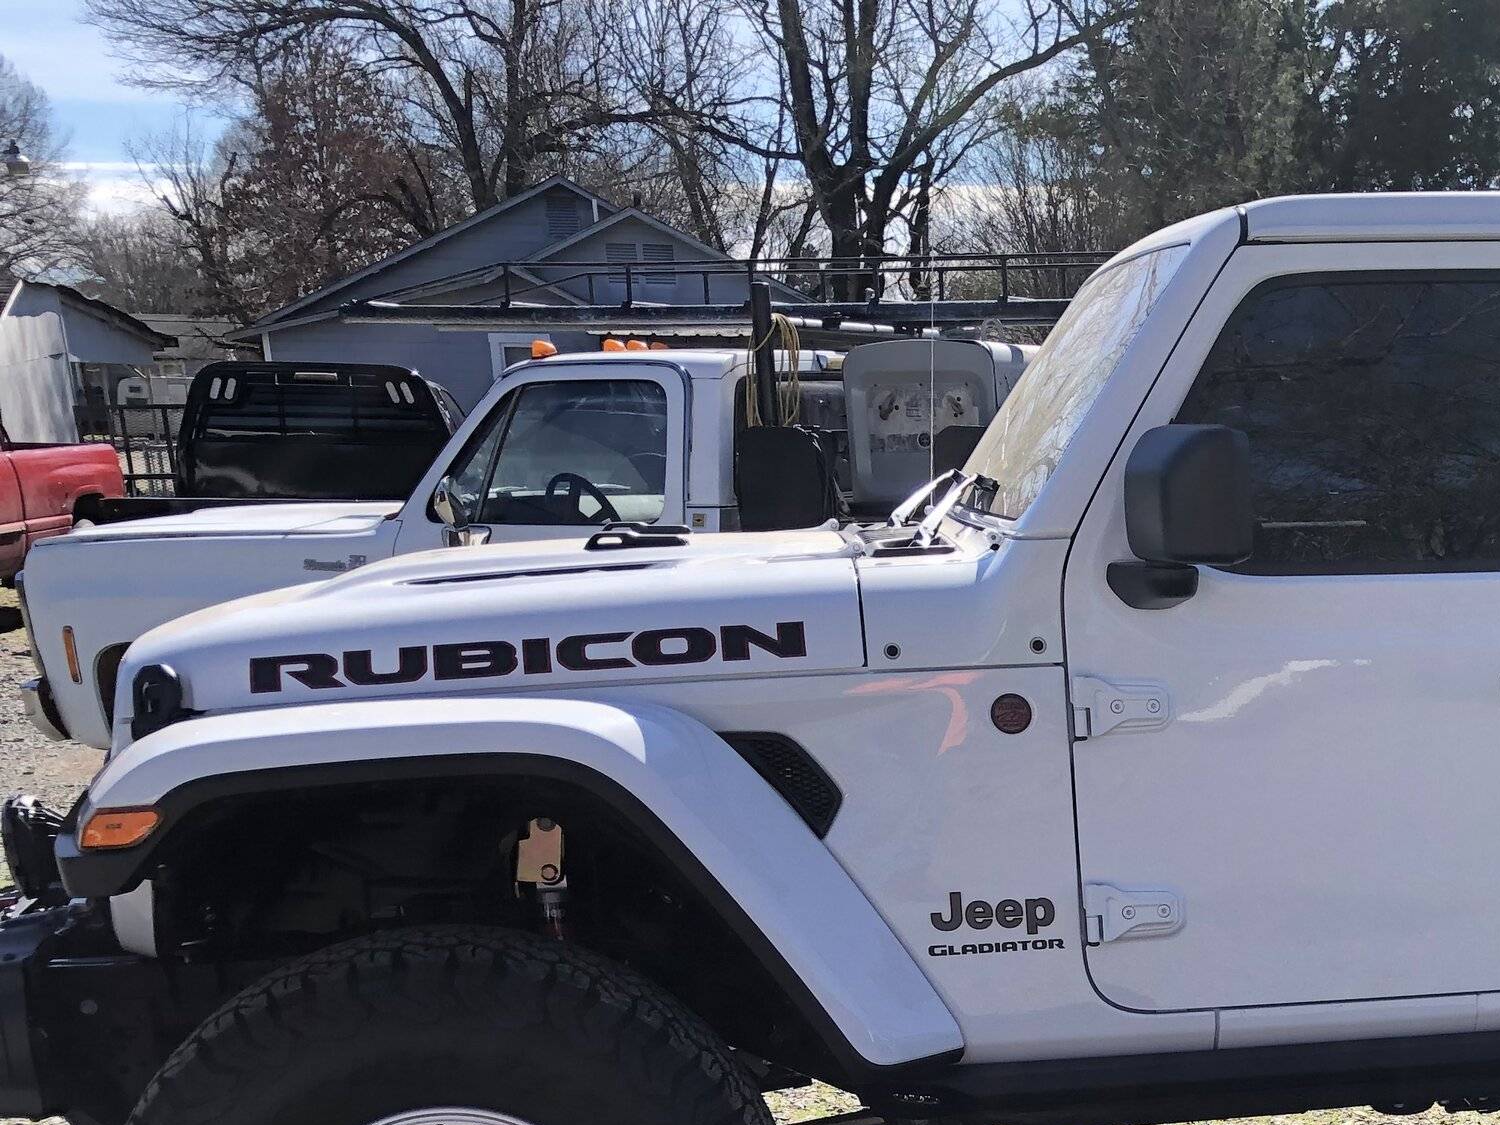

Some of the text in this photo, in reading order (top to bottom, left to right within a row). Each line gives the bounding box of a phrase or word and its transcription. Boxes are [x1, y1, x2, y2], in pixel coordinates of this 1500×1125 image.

[250, 621, 807, 693] RUBICON
[930, 891, 1055, 934] Jeep
[928, 938, 1065, 957] GLADIATOR
